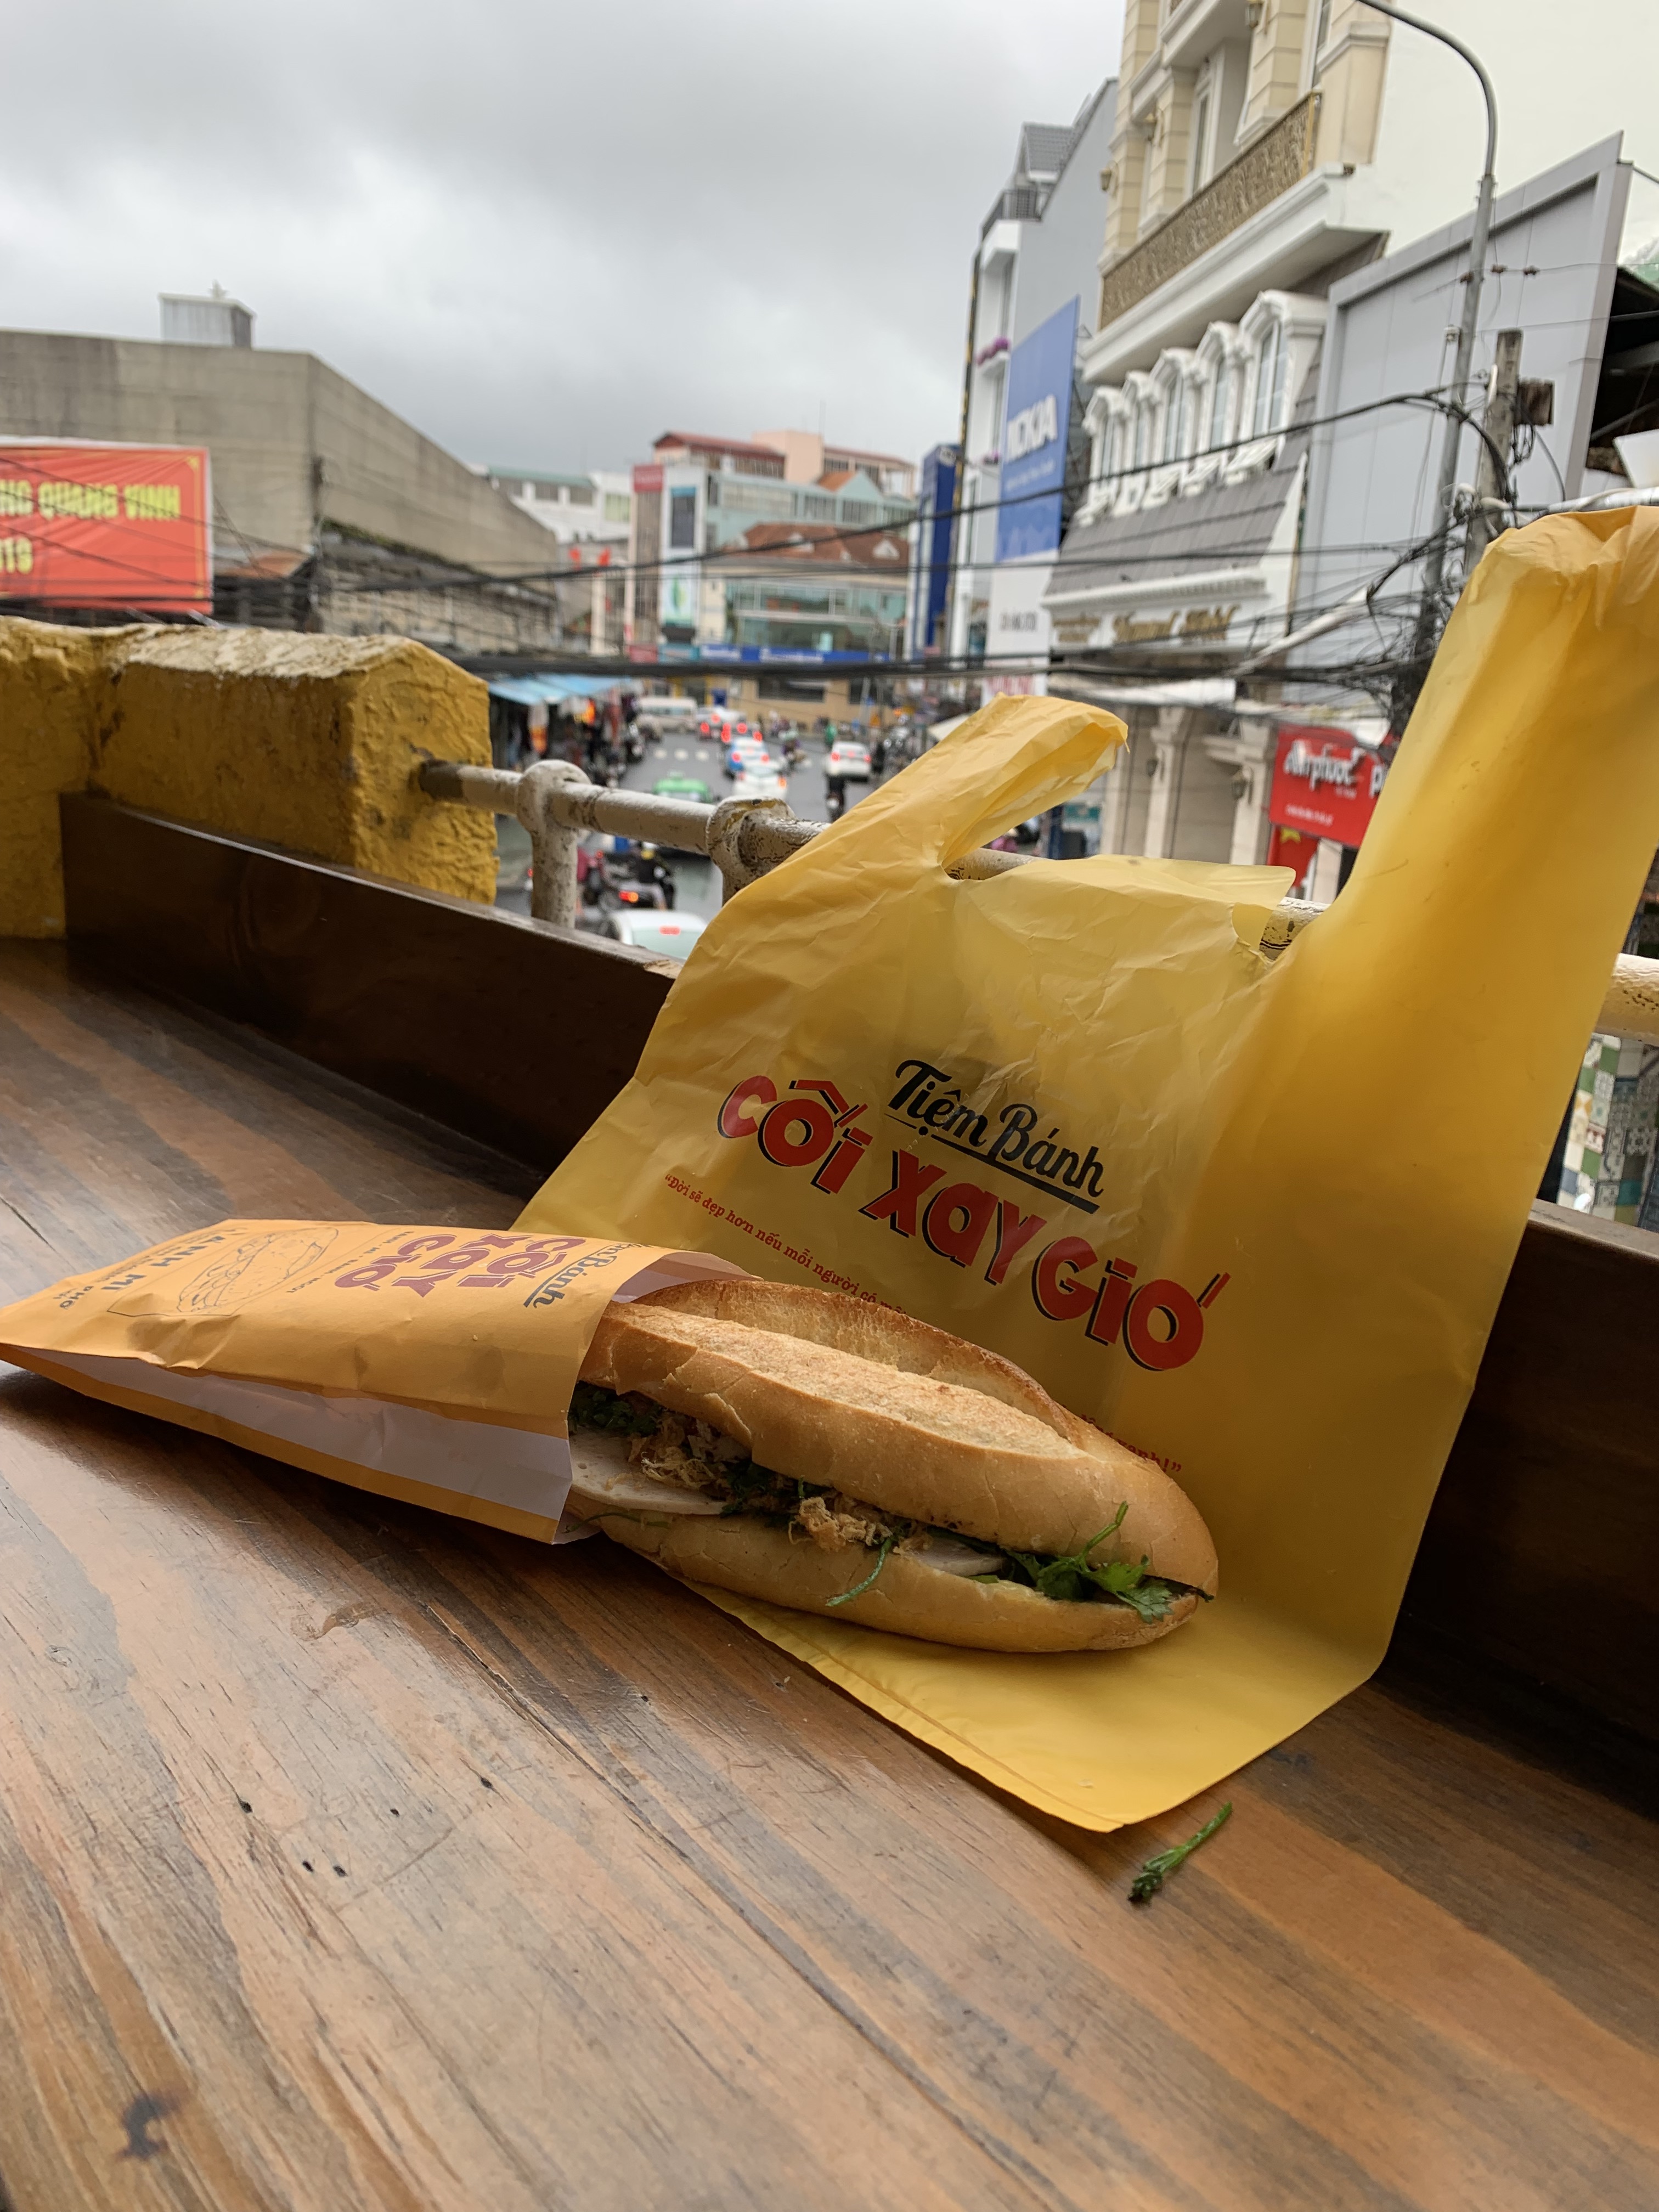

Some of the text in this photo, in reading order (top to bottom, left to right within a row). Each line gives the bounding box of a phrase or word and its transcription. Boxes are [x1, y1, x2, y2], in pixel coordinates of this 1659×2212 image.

[887, 1059, 1104, 1198] Tiệm Bánh
[532, 1255, 618, 1308] Bánh
[689, 1190, 703, 1203] sẽ
[702, 1197, 725, 1218] đẹp
[725, 1209, 754, 1234] hơn
[754, 1229, 783, 1251] nếu
[783, 1248, 814, 1269] mỗi
[812, 1262, 860, 1296] người
